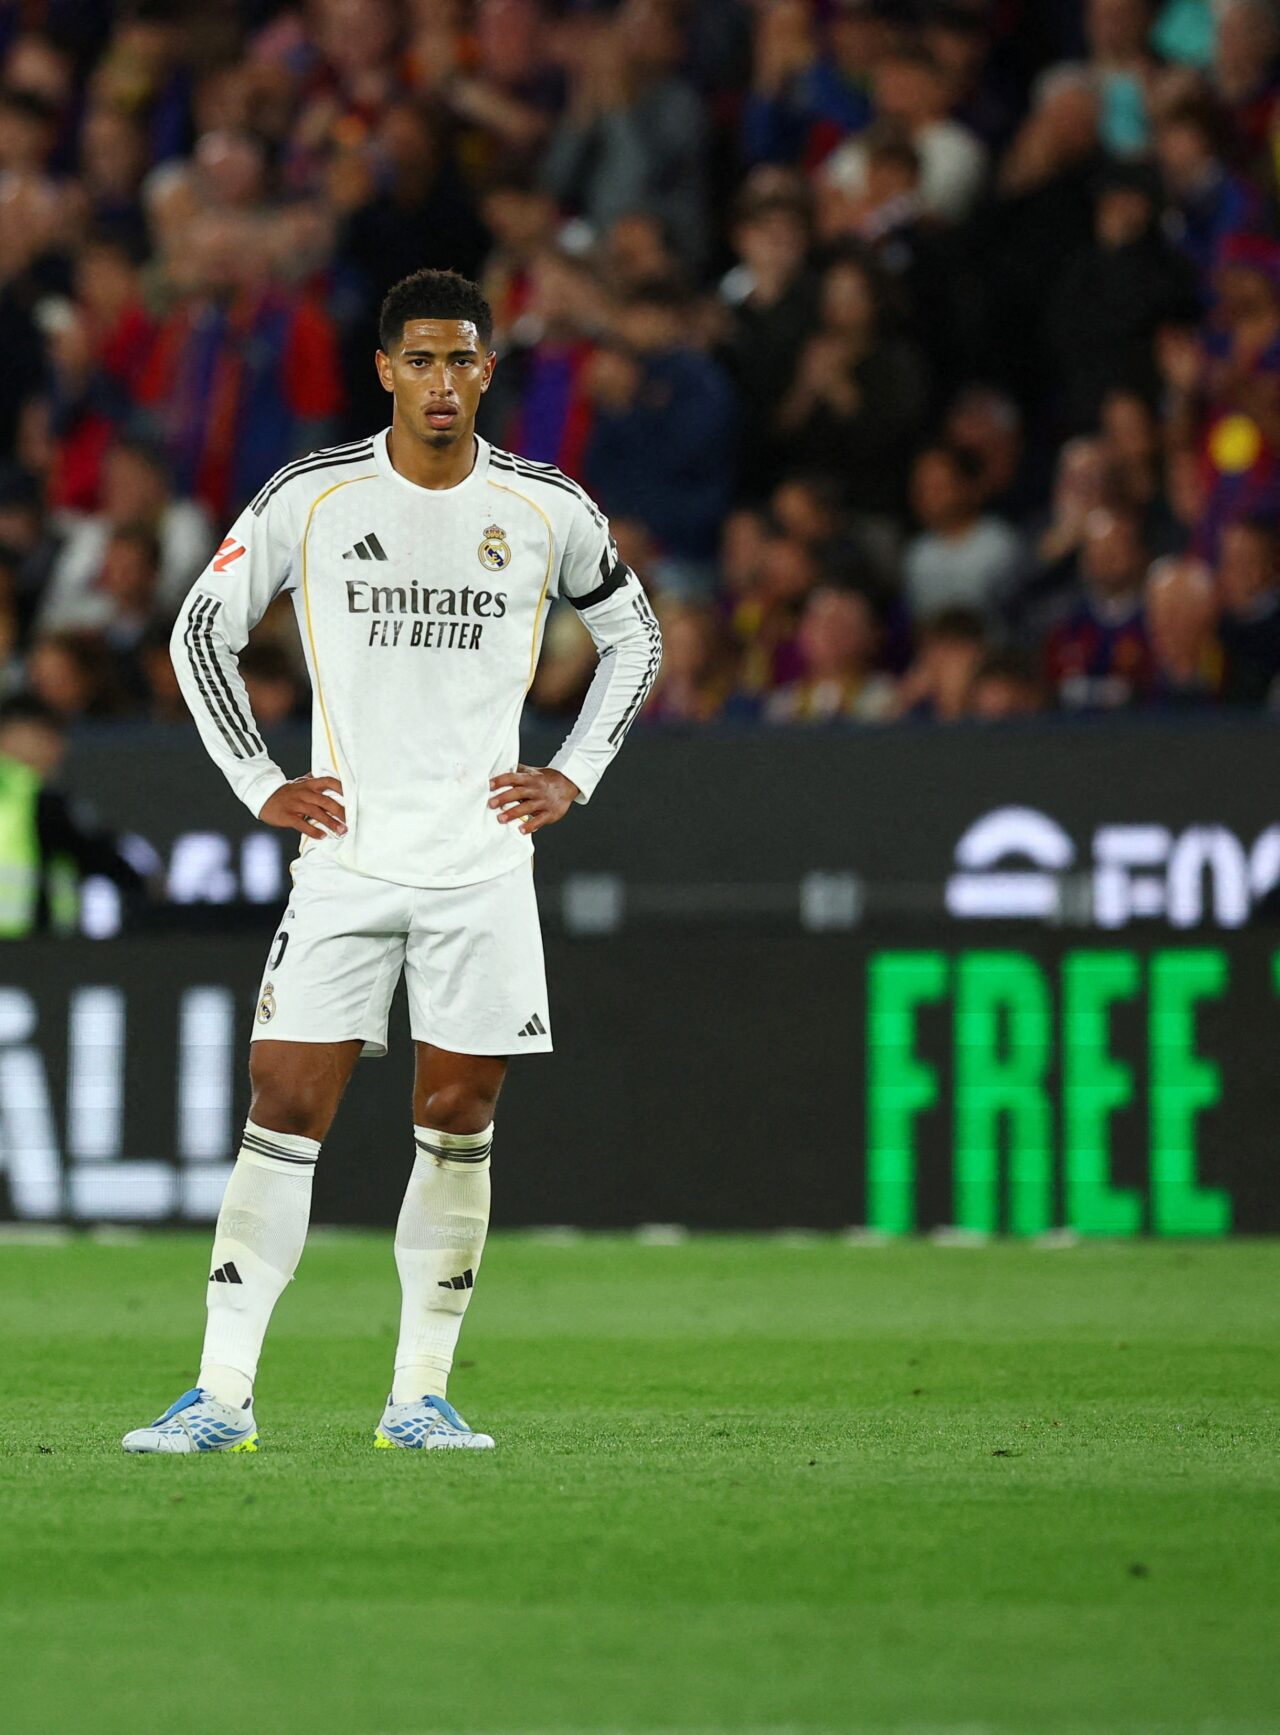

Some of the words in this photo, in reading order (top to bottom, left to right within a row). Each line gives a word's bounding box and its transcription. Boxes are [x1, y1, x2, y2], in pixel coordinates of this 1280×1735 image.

[345, 579, 507, 618] Emirates
[369, 620, 403, 647] FLY
[410, 621, 483, 650] BETTER
[867, 948, 1231, 1238] FREE
